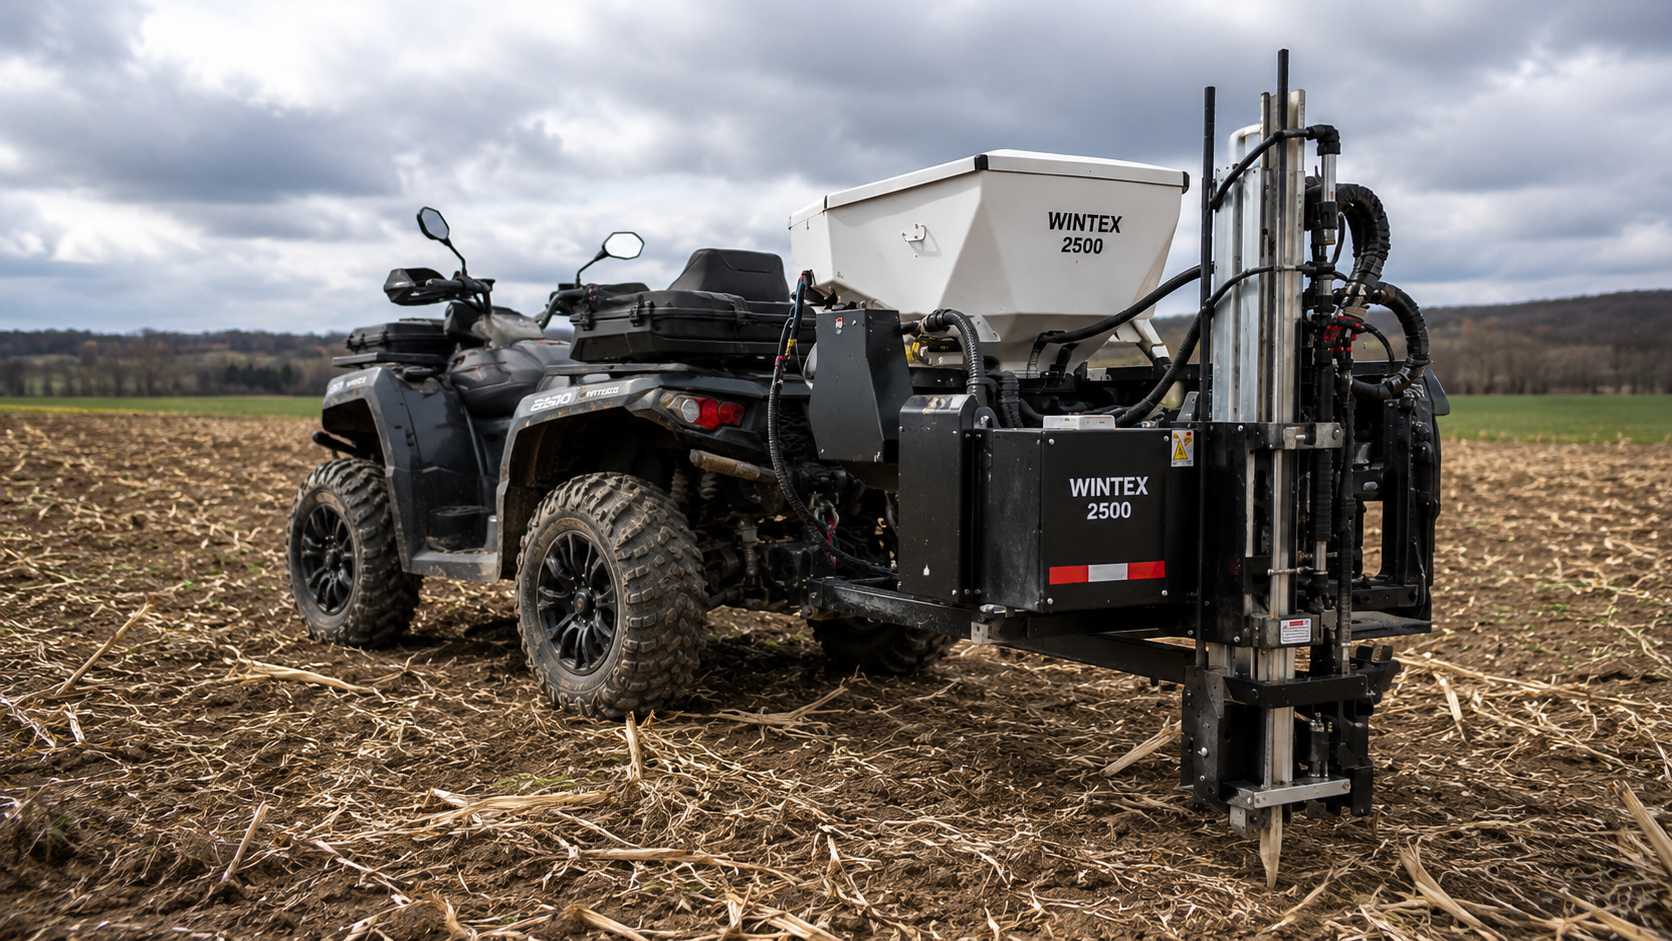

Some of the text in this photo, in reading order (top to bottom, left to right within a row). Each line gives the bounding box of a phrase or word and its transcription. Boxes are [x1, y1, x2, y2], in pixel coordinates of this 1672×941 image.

[1048, 211, 1123, 234] WINTEX
[1061, 236, 1103, 254] 2500
[1069, 476, 1149, 497] WINTEX
[1086, 501, 1132, 520] 2500
